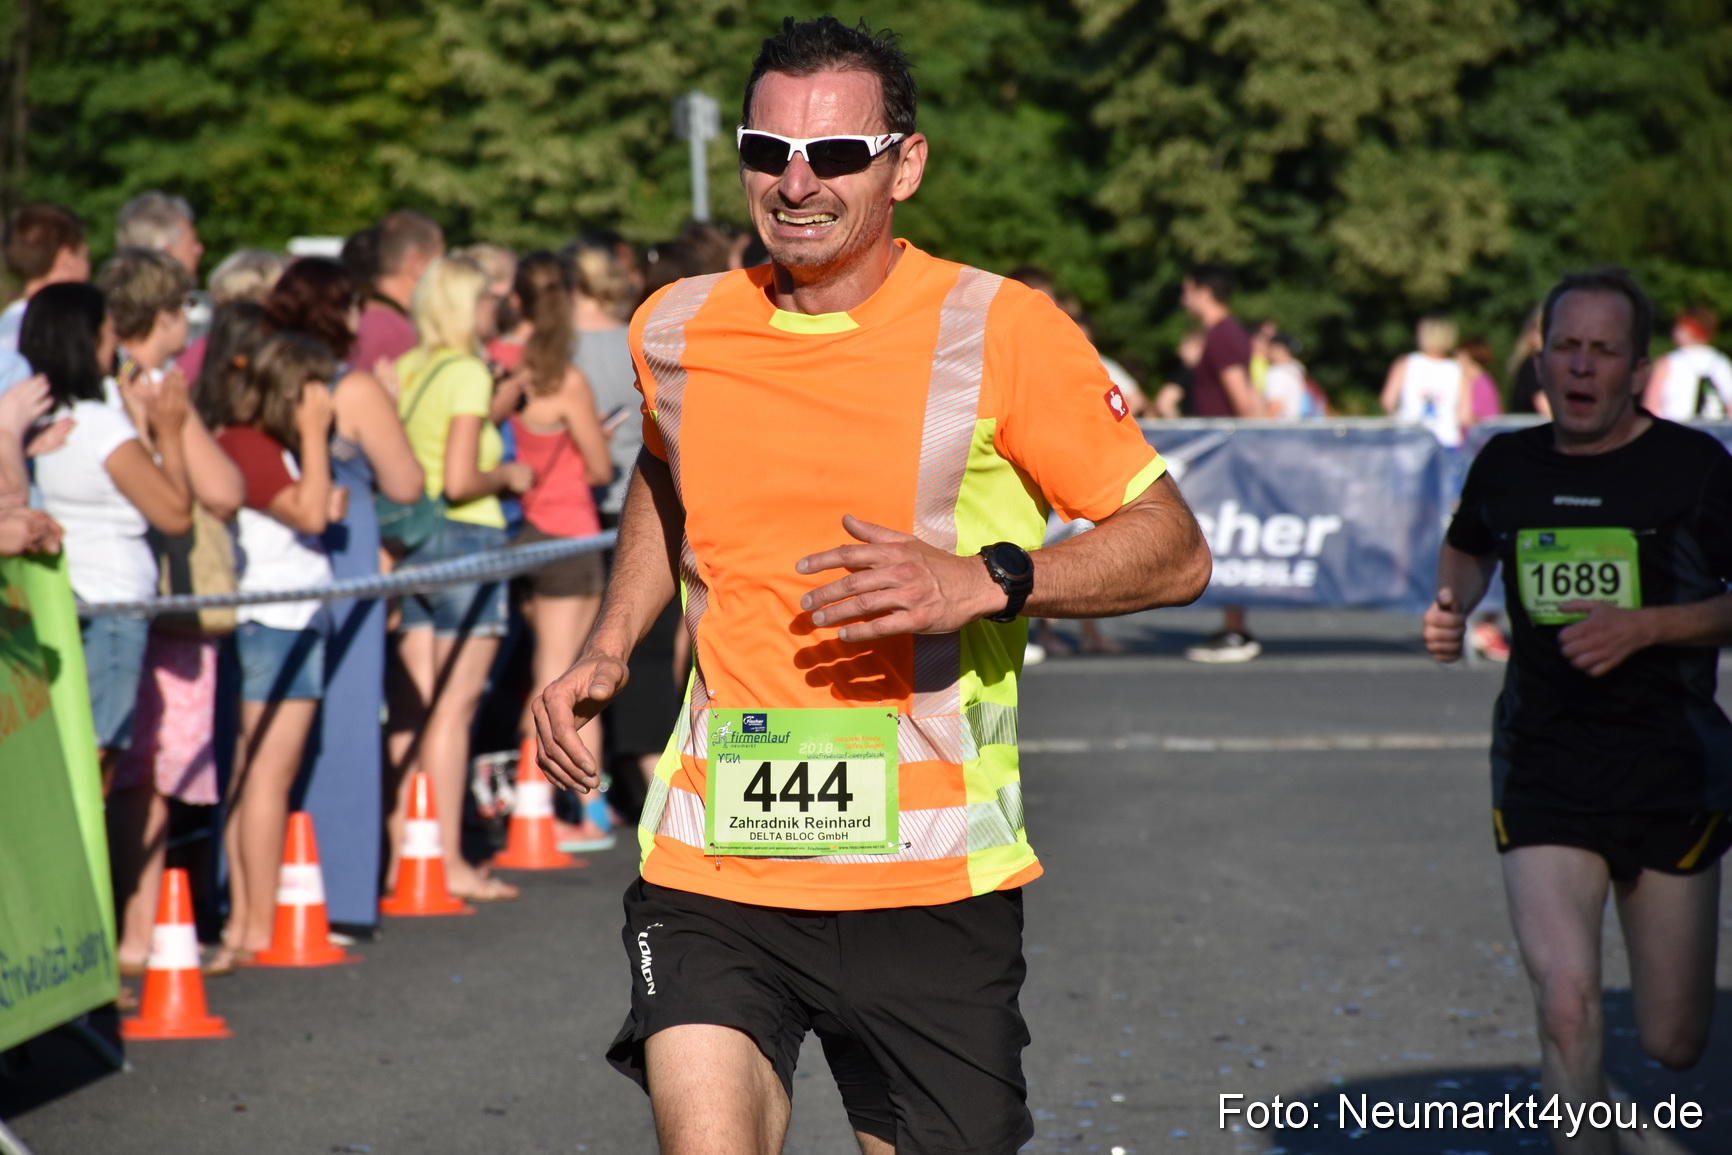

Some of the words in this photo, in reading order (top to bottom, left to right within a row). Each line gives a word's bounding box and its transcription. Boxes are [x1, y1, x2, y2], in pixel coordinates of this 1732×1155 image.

[1531, 562, 1621, 597] 1689
[731, 731, 791, 744] firmenlauf
[799, 742, 833, 754] 2018
[743, 761, 853, 812] 444
[729, 816, 800, 829] Zahradnik
[805, 816, 871, 828] Reinhard
[750, 832, 782, 841] DELTA
[786, 832, 814, 841] BLOC
[818, 832, 848, 840] GmbH
